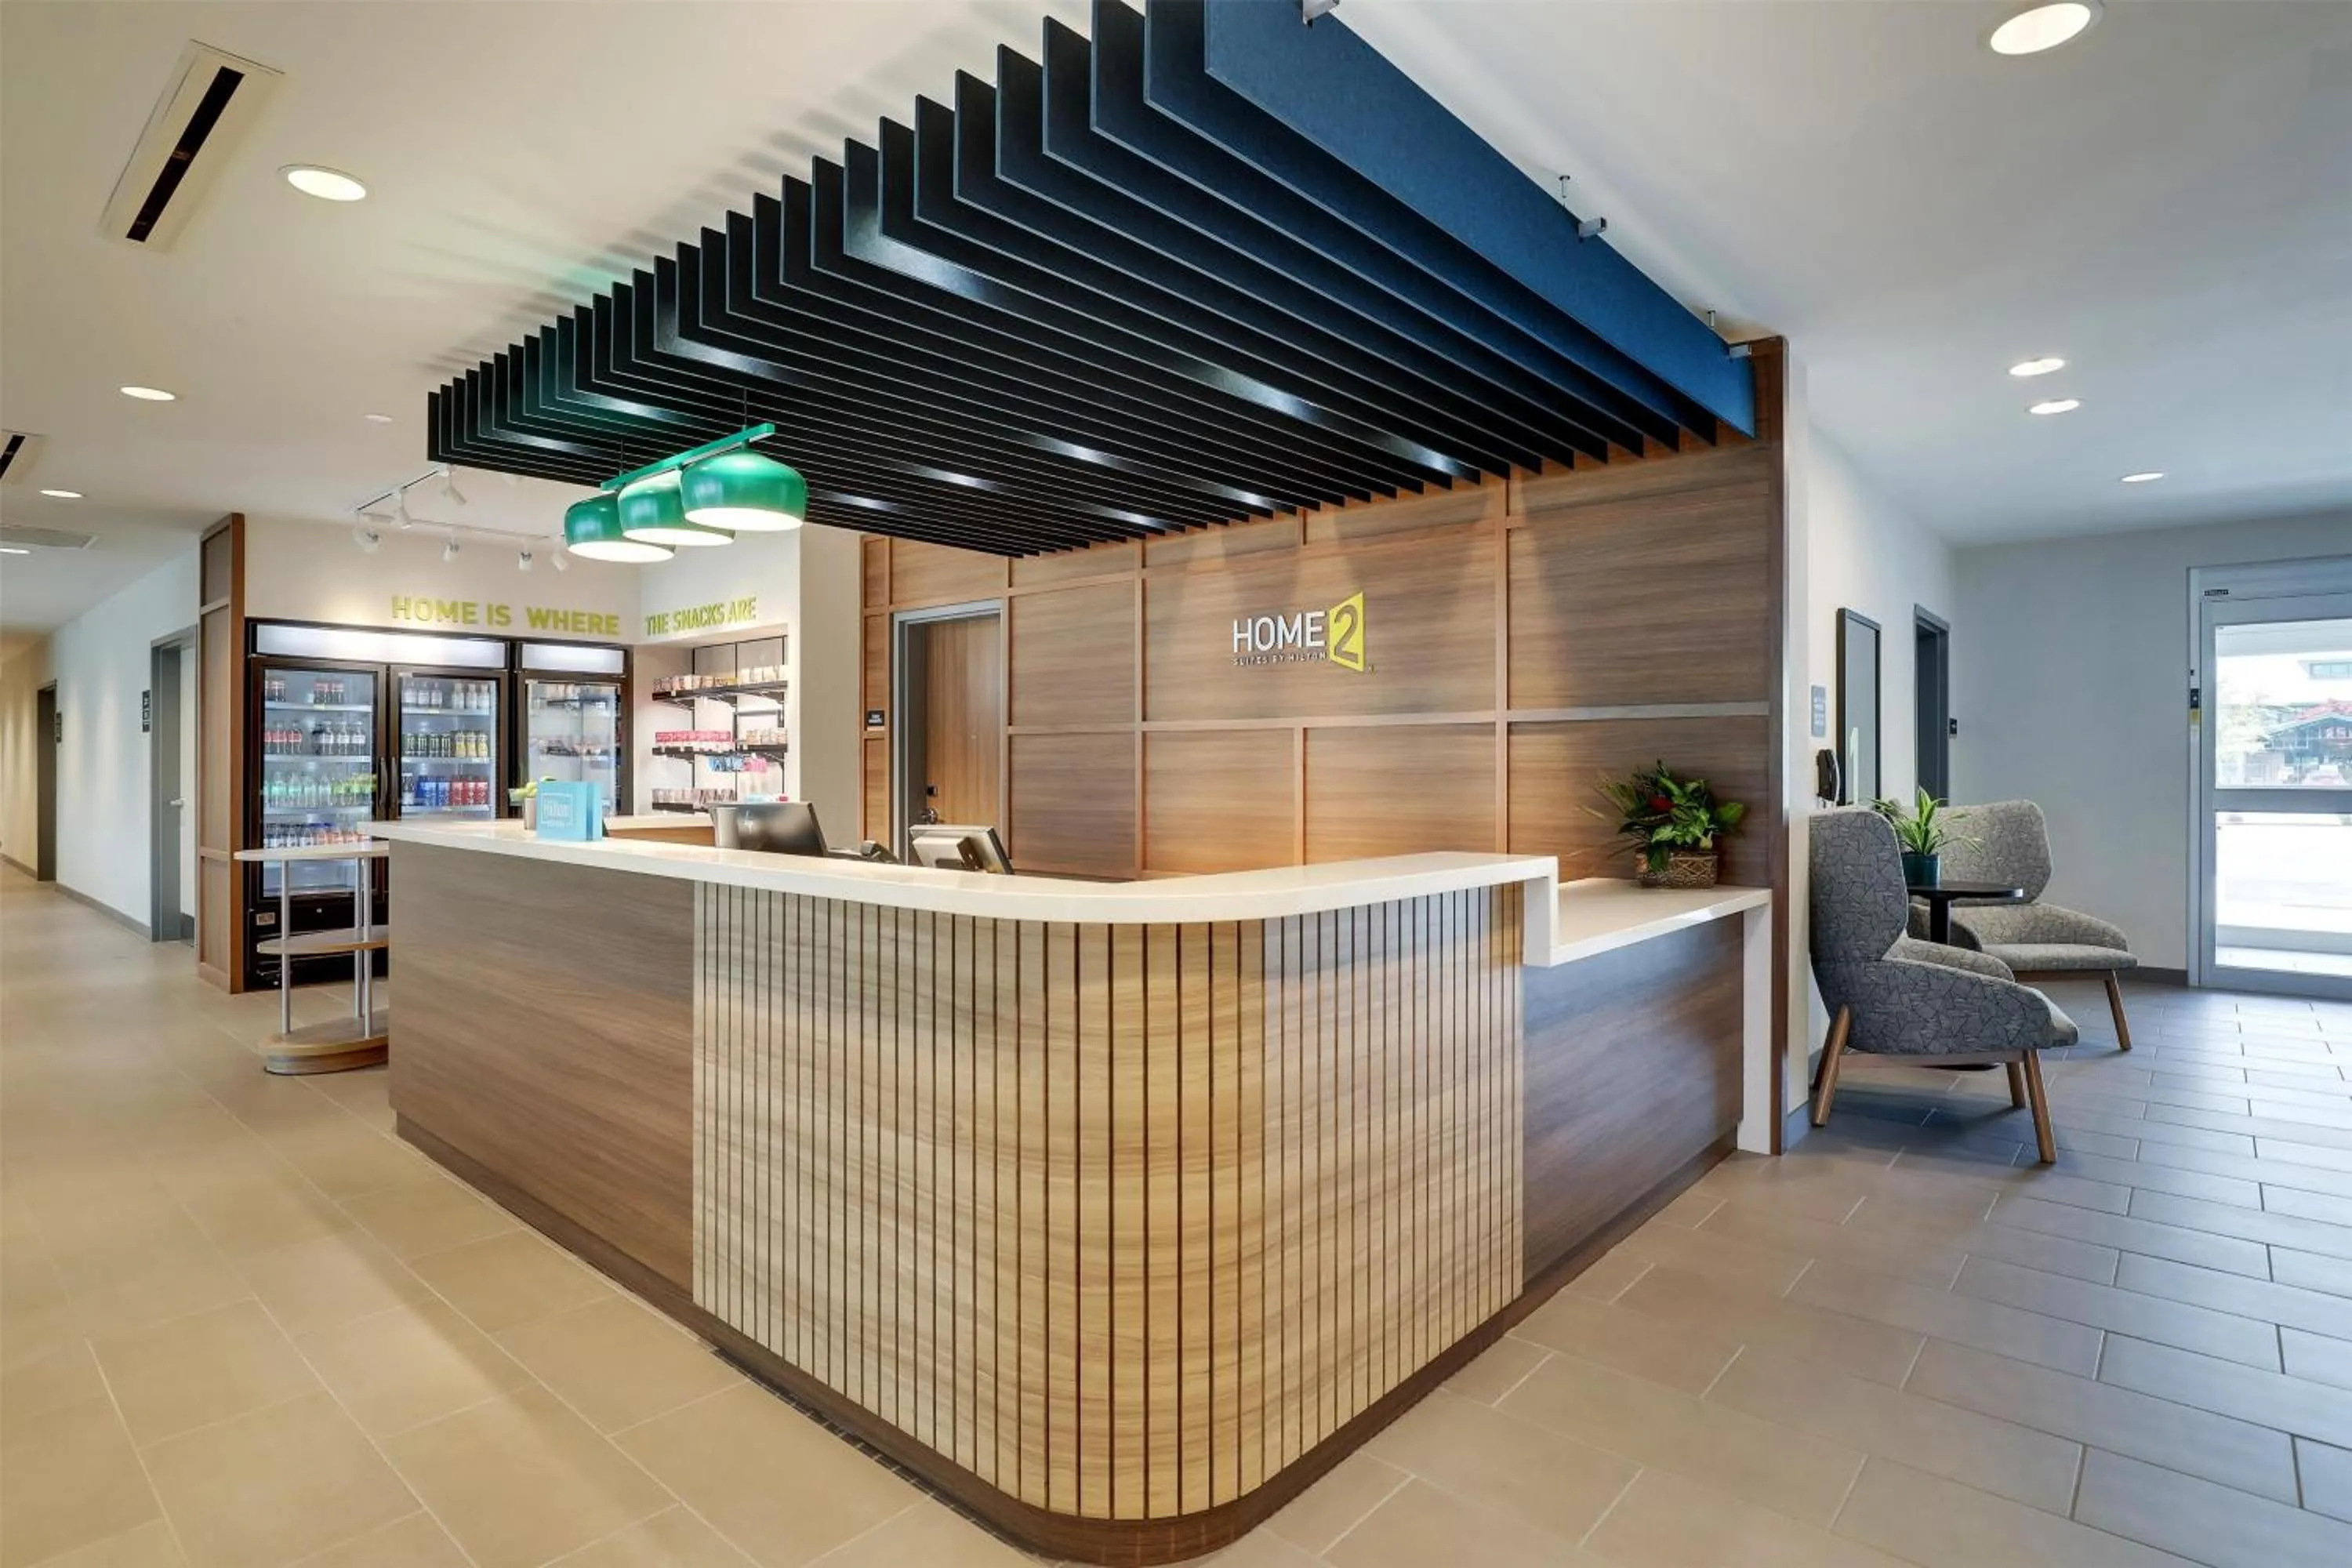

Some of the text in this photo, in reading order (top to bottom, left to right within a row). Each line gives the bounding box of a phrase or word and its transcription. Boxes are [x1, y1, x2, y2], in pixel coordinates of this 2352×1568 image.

[391, 595, 620, 636] HOME IS WHERE
[645, 597, 757, 637] THE SNACKS ARE
